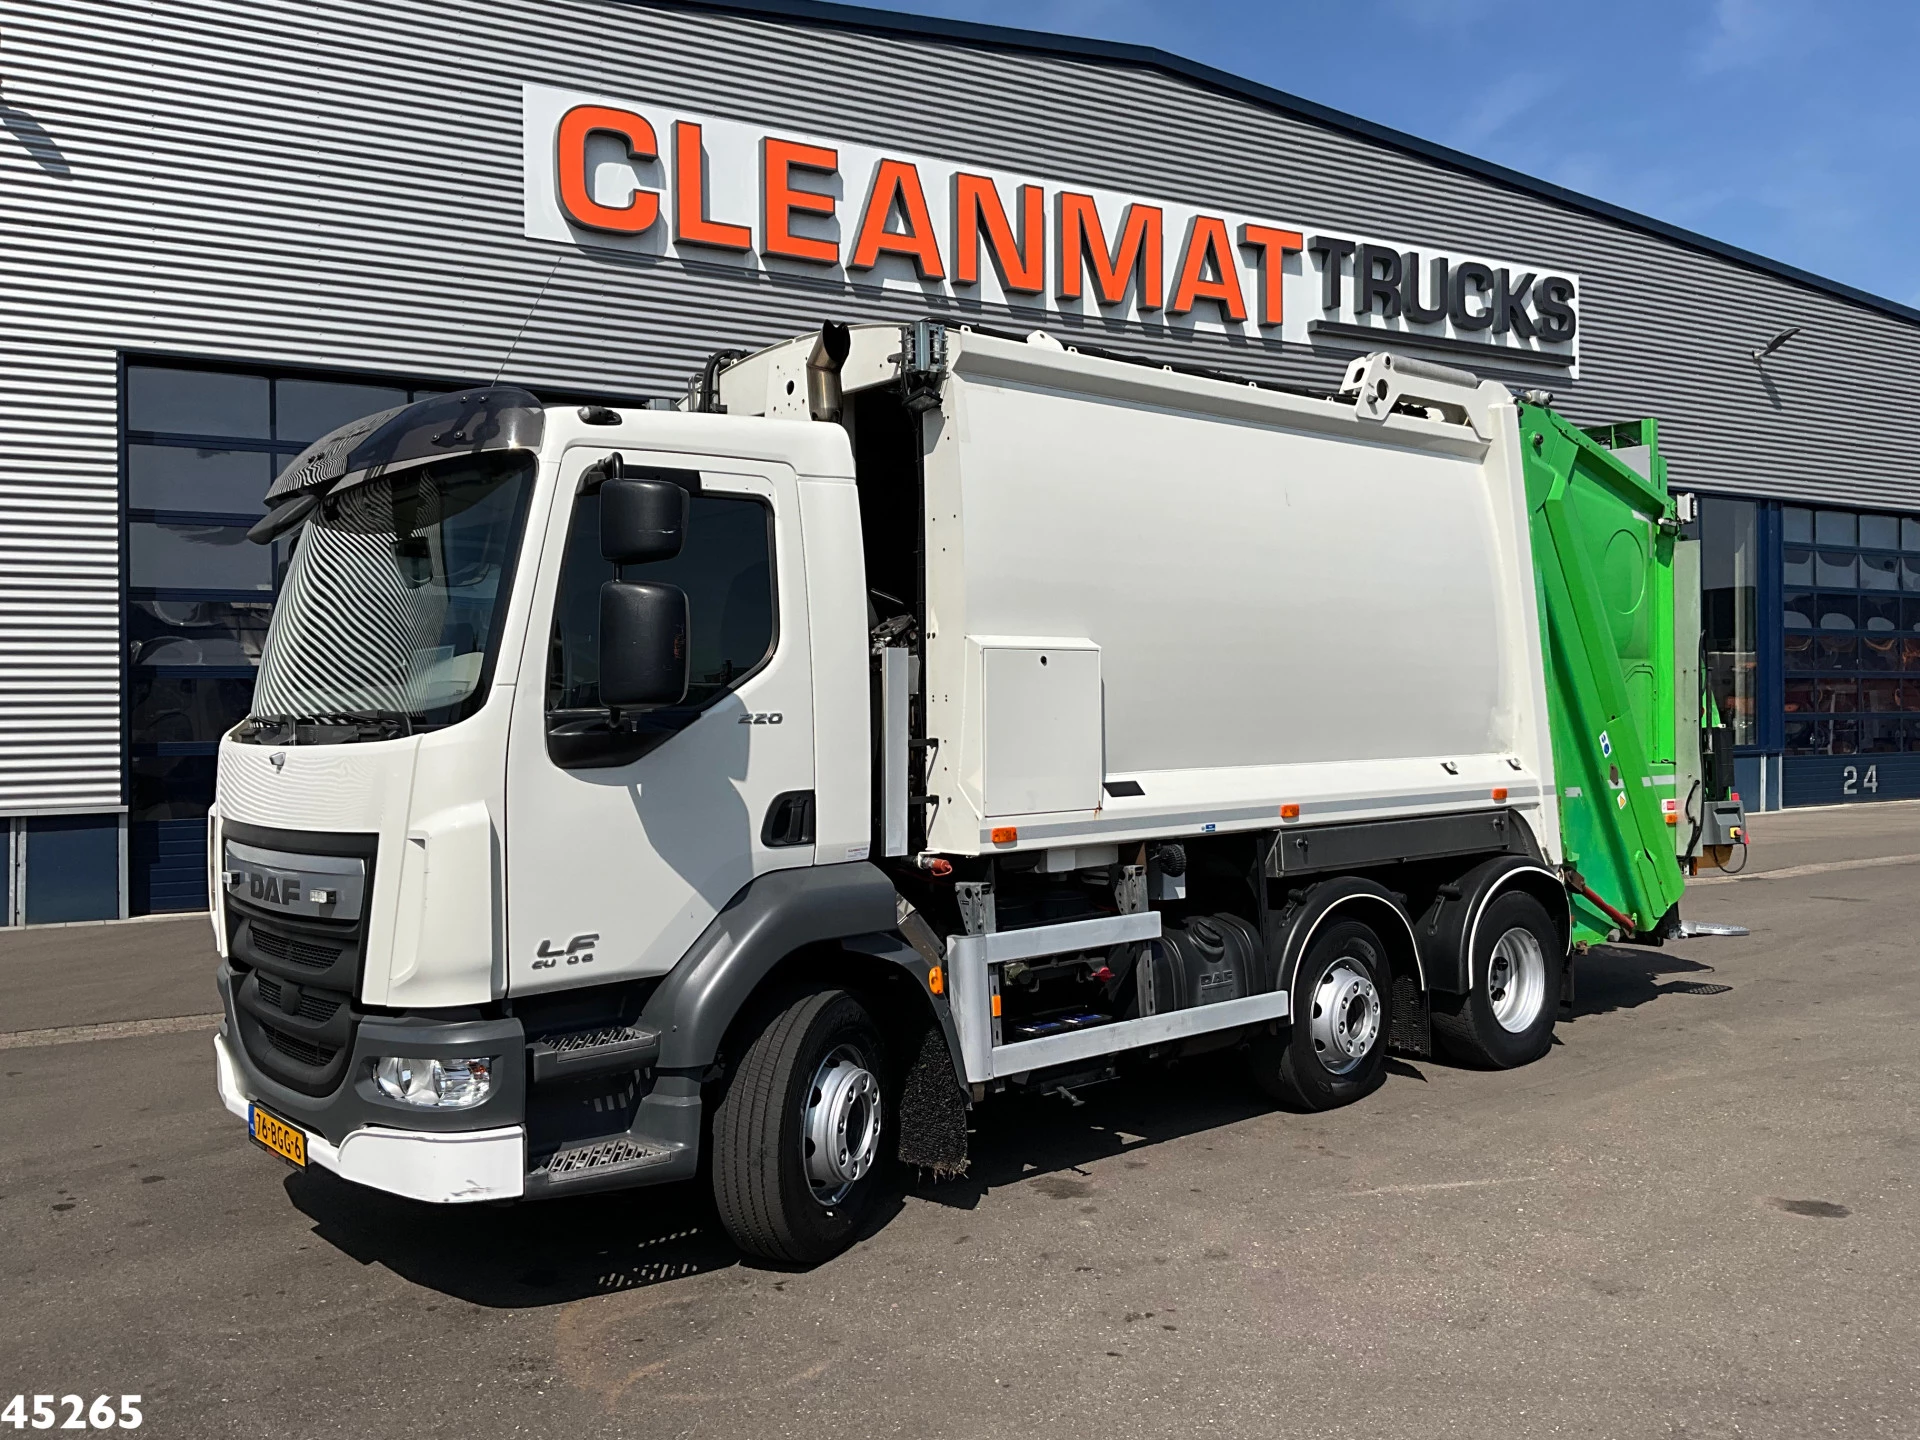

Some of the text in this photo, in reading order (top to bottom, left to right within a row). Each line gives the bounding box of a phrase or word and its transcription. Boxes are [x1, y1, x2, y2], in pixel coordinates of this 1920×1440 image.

[556, 104, 1577, 342] CLEANMAT TRUCKS
[738, 713, 783, 725] 220
[1843, 765, 1879, 794] 24
[250, 872, 301, 906] DAF
[537, 933, 600, 958] LF
[255, 1112, 303, 1160] 76-BGG-6
